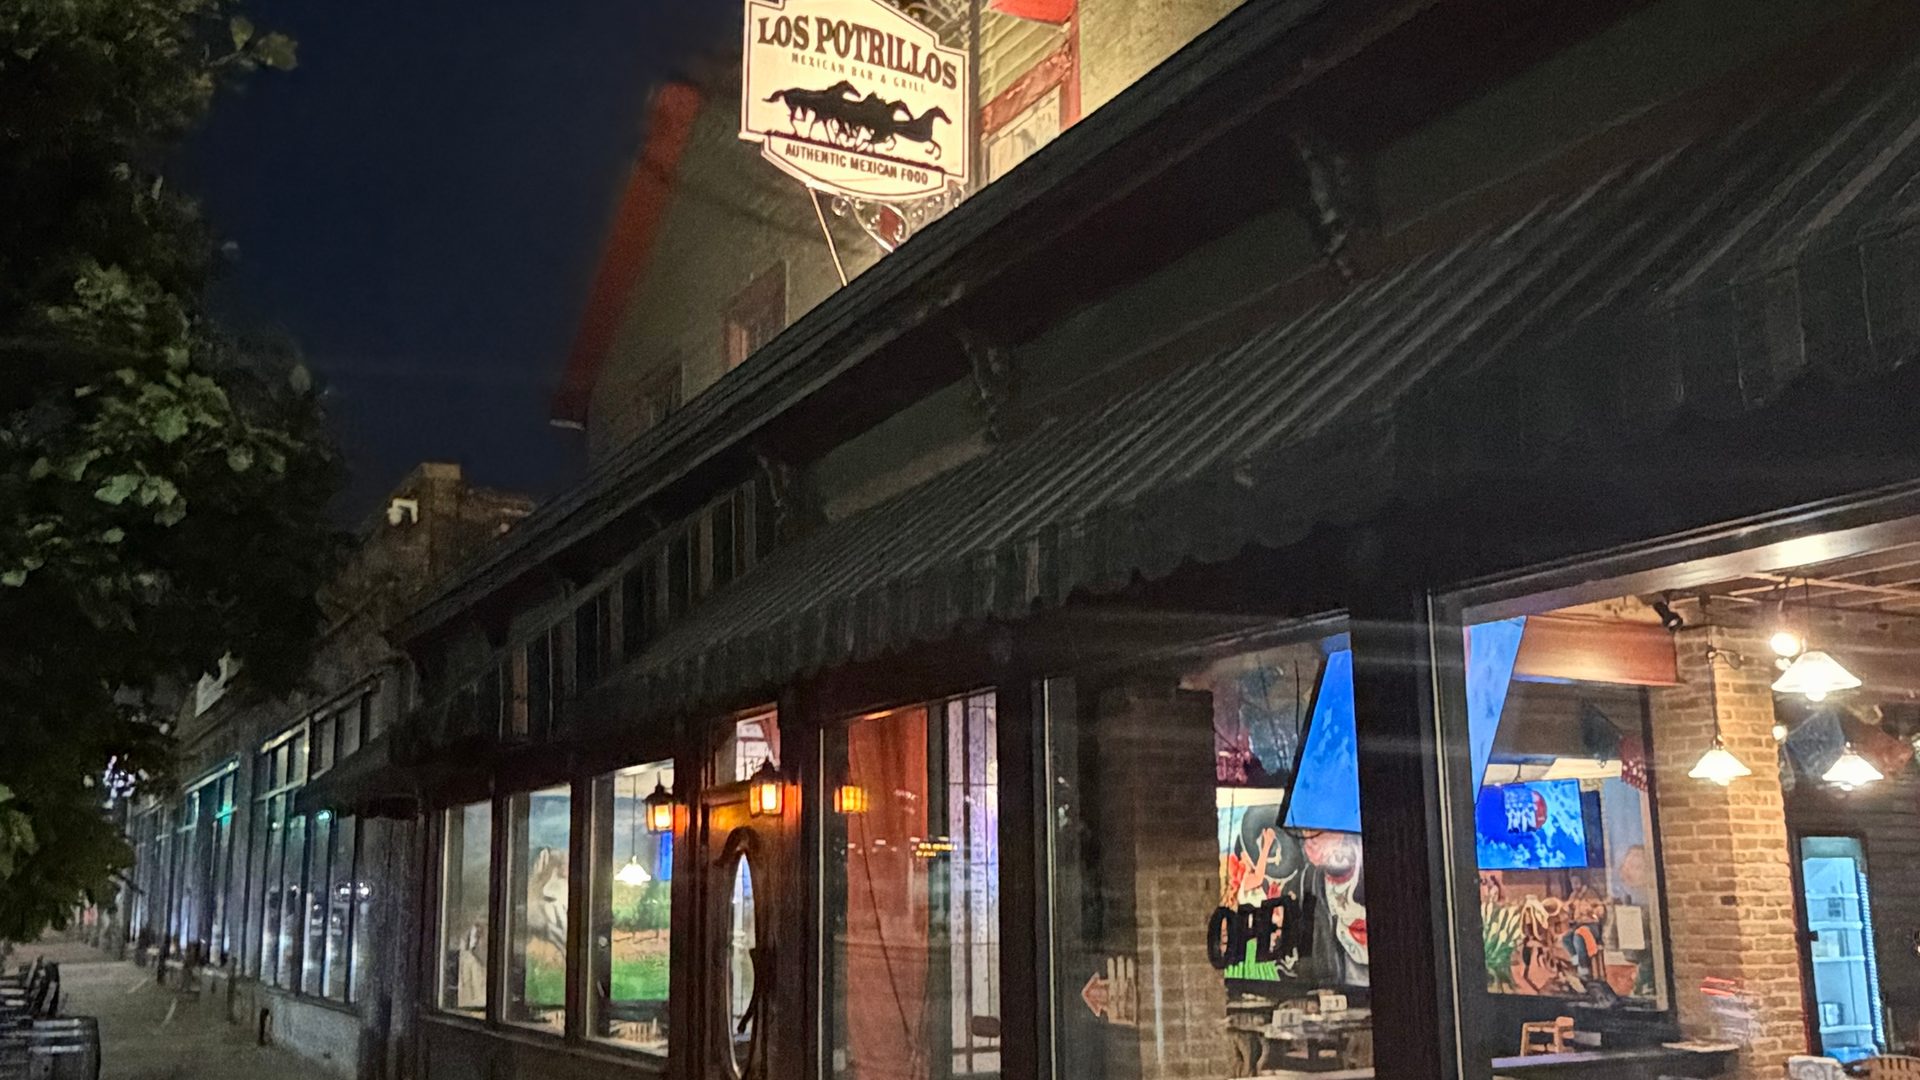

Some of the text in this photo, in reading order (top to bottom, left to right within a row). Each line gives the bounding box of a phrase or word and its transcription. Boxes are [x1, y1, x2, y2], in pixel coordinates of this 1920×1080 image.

[757, 15, 957, 90] LOS POTRILLOS
[792, 52, 926, 94] MEXICAN BAR & GRILL
[785, 143, 928, 185] AUTHENTIC MEXICAN FOOD
